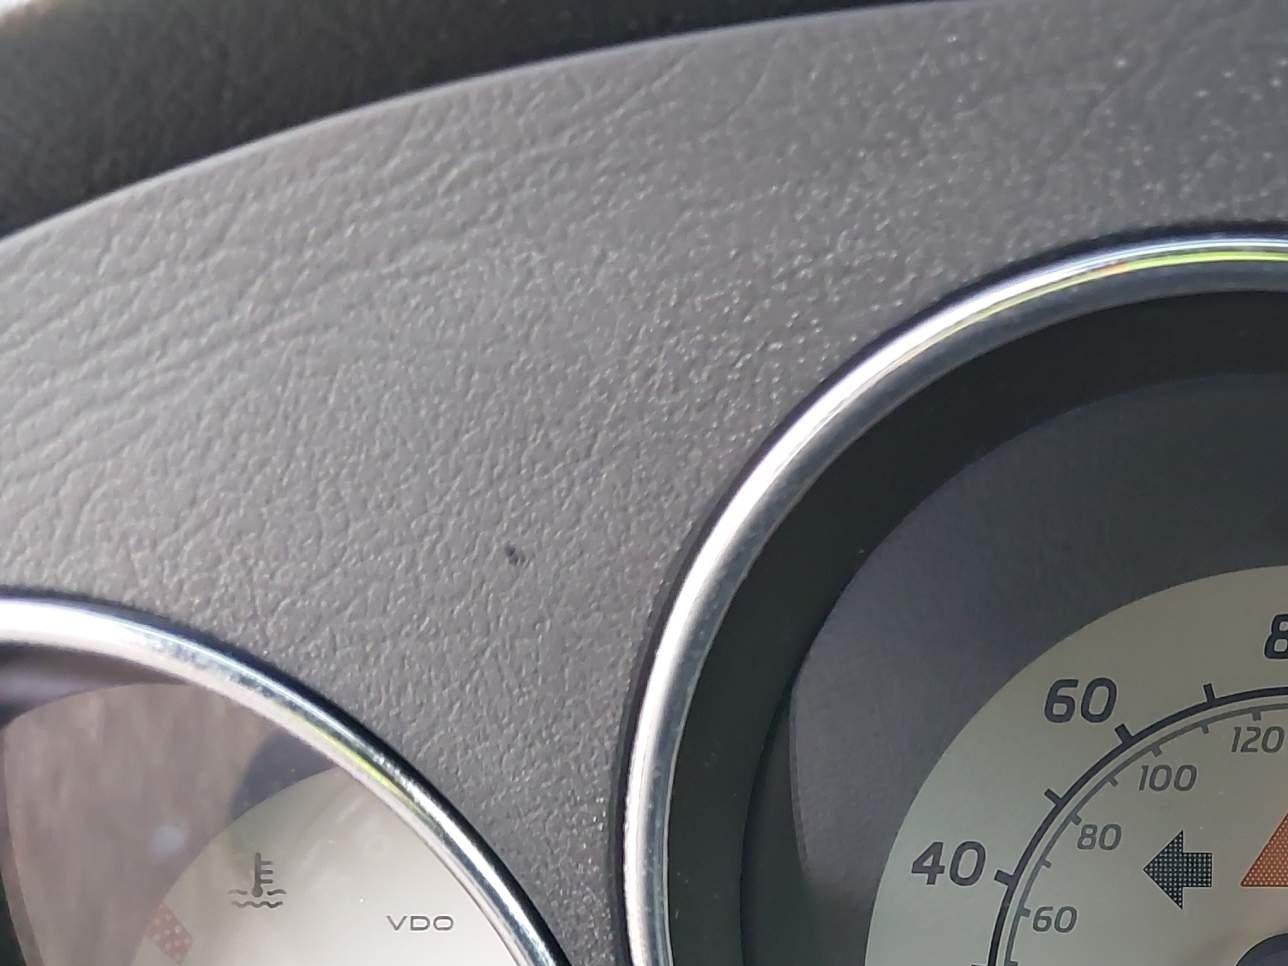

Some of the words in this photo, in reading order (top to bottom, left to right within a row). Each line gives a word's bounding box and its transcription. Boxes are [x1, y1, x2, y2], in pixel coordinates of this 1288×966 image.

[1044, 677, 1118, 724] 60
[1231, 726, 1285, 754] 120
[1138, 764, 1198, 792] 100
[1077, 823, 1122, 851] 80
[911, 841, 987, 887] 40
[386, 915, 455, 931] VDO
[1032, 906, 1078, 934] 60
